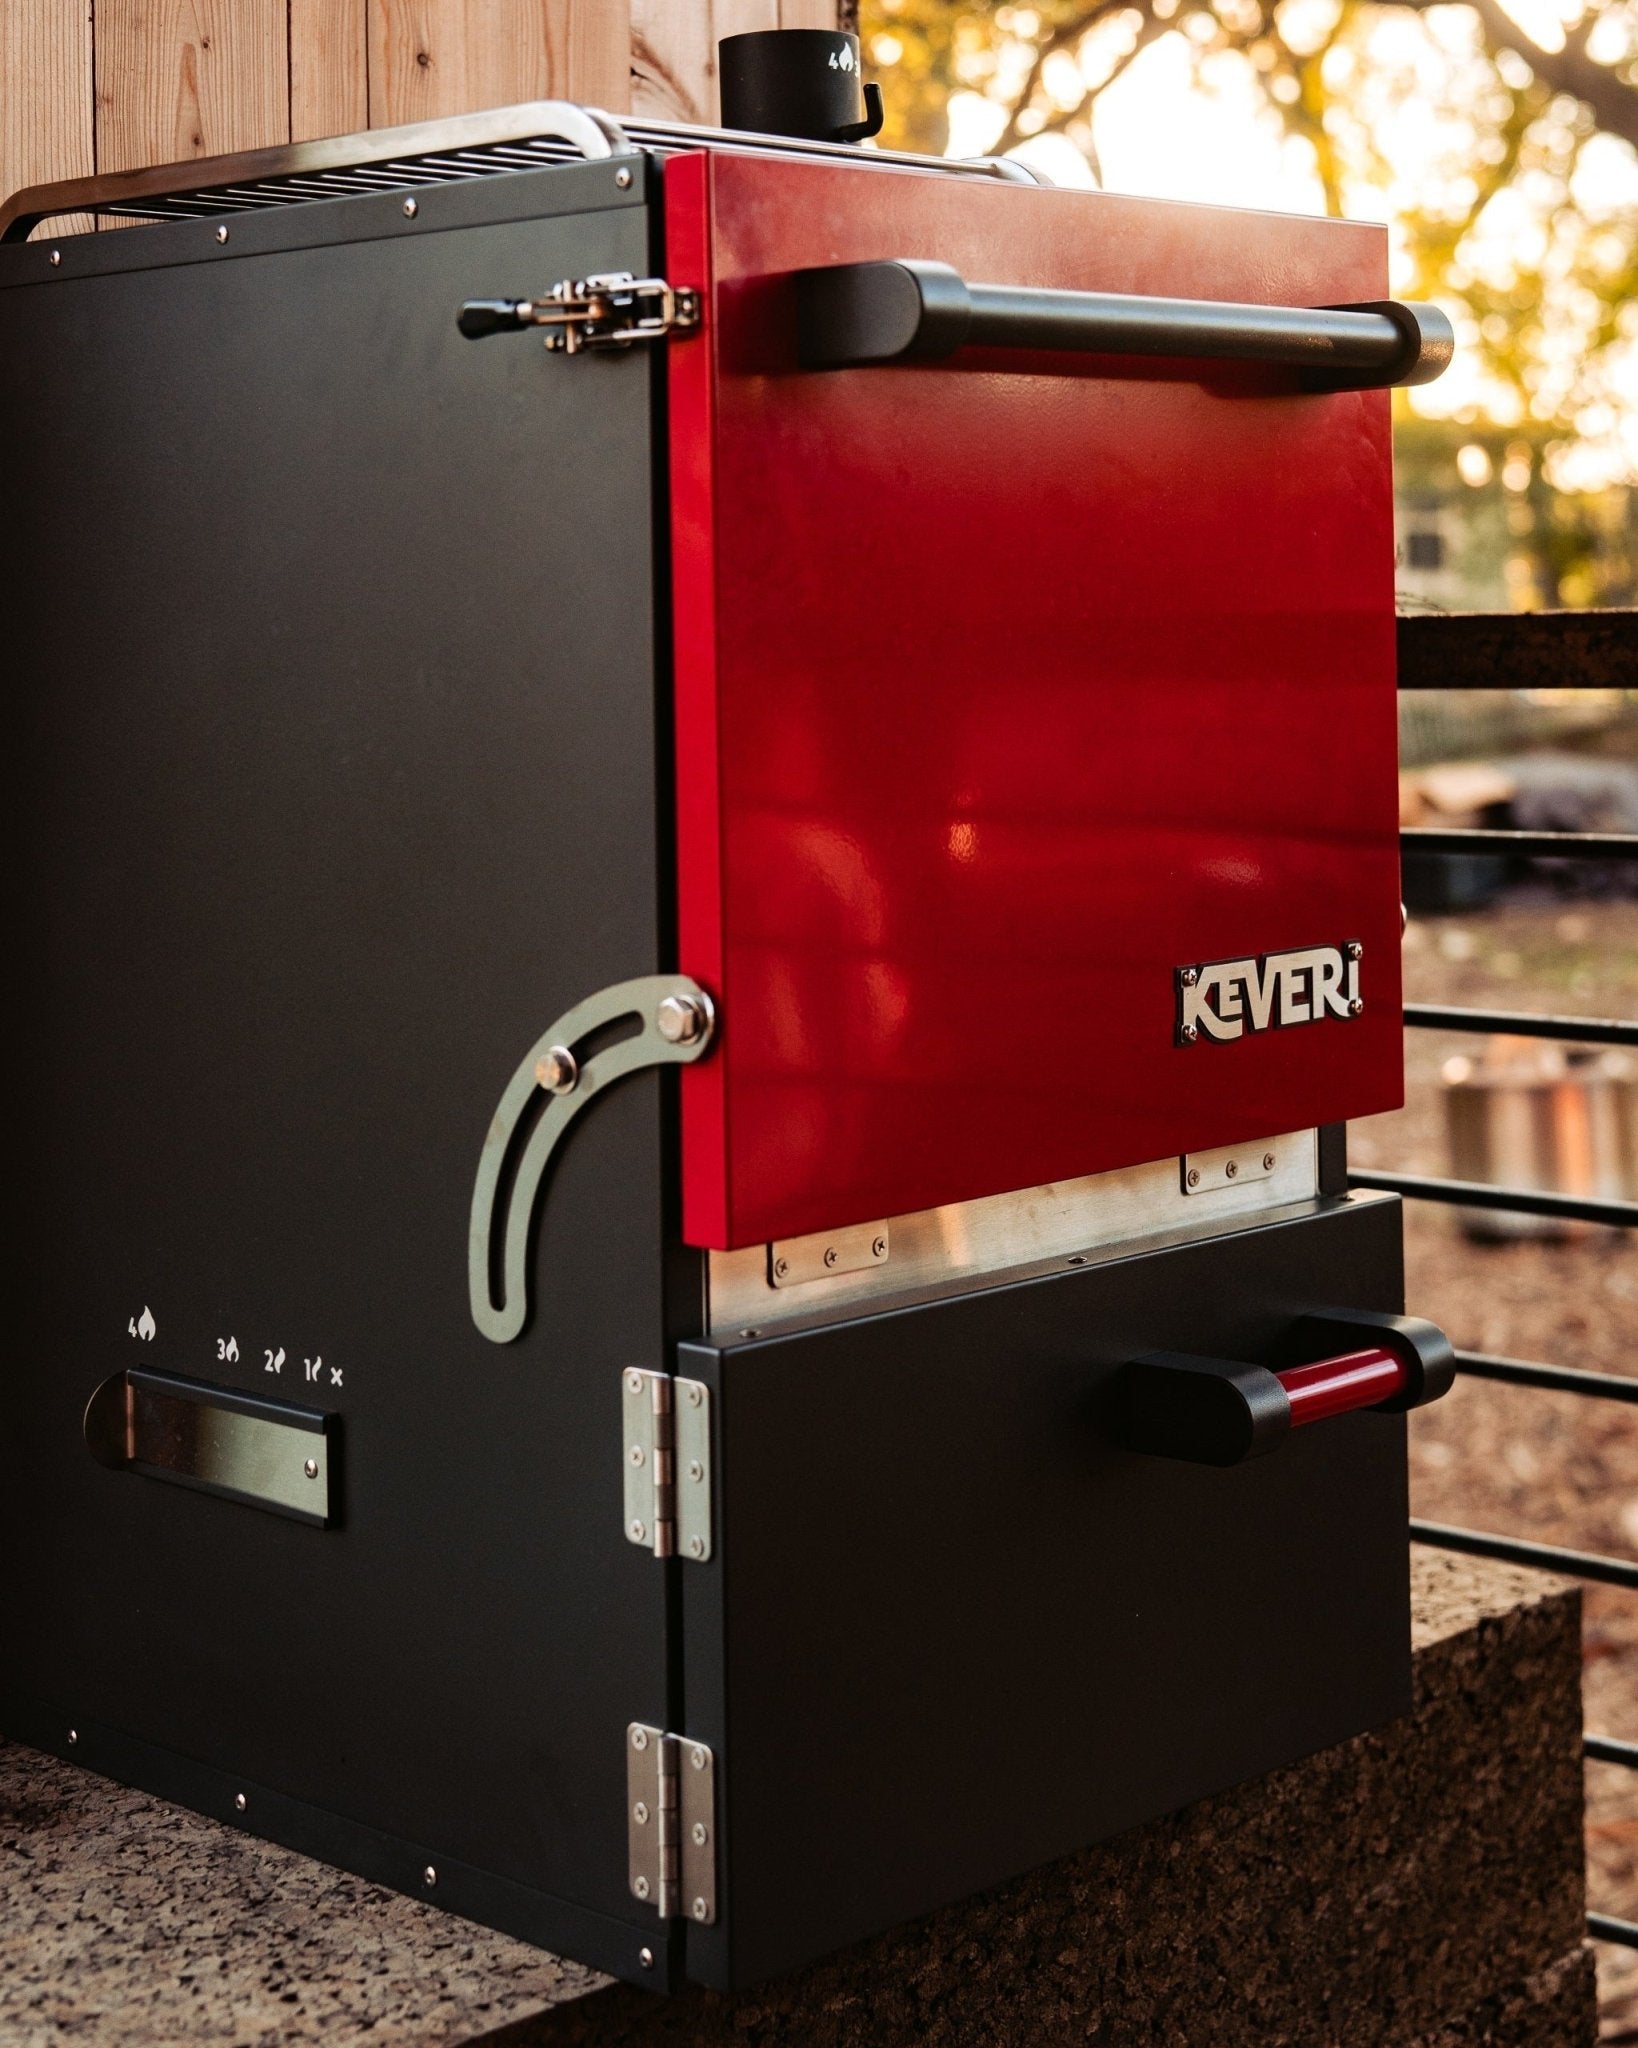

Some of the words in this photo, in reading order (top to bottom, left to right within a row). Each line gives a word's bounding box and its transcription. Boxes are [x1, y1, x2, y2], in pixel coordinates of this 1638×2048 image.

[828, 52, 839, 70] 4
[128, 1317, 138, 1338] 4
[216, 1338, 226, 1360] 3
[264, 1349, 274, 1372] 2
[304, 1358, 311, 1381] 1
